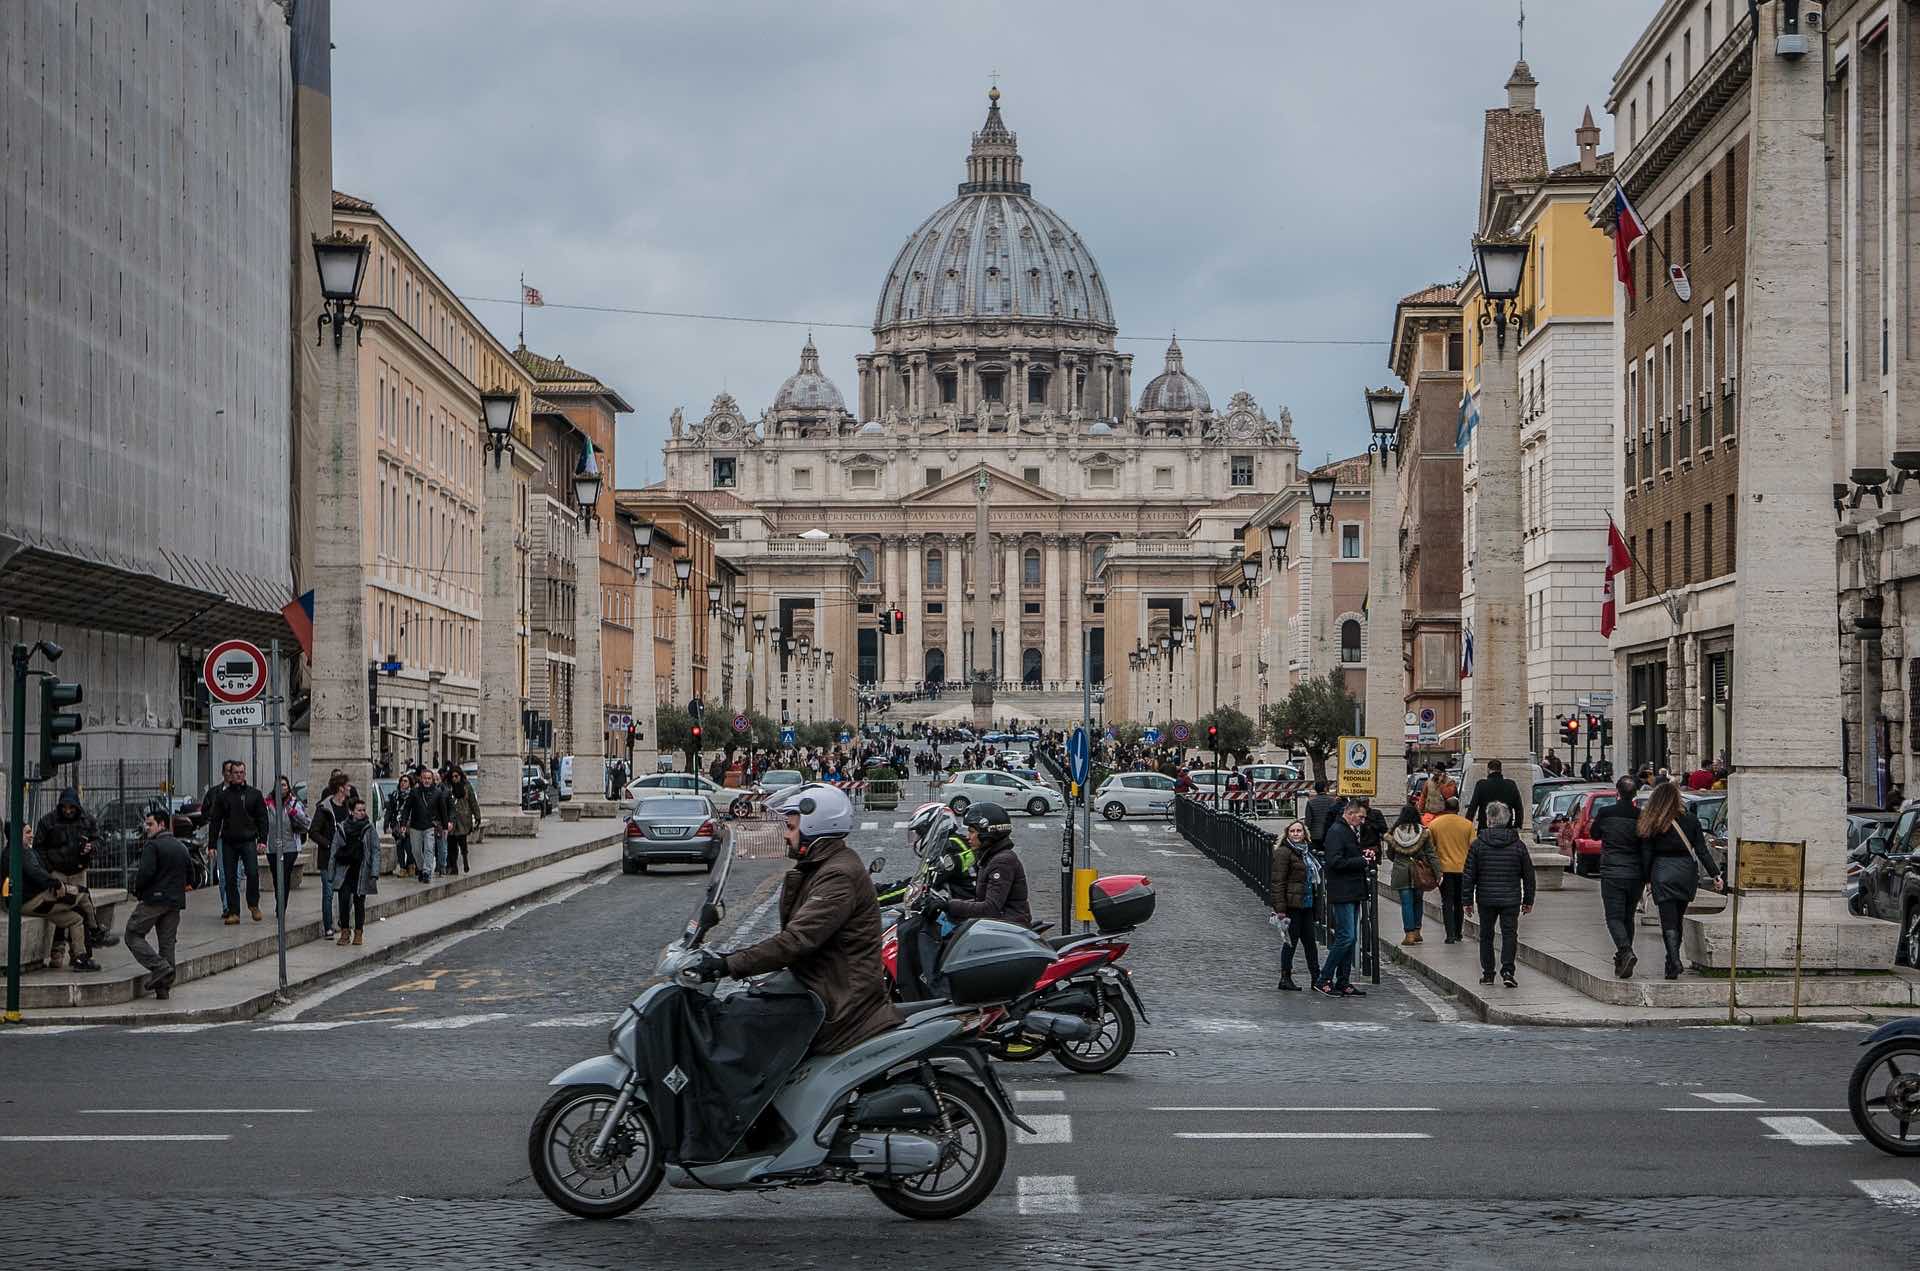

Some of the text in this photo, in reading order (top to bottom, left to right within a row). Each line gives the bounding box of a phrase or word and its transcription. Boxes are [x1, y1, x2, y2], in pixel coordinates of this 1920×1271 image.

[228, 680, 233, 689] 6
[220, 706, 256, 716] eccetto
[228, 717, 248, 725] atac
